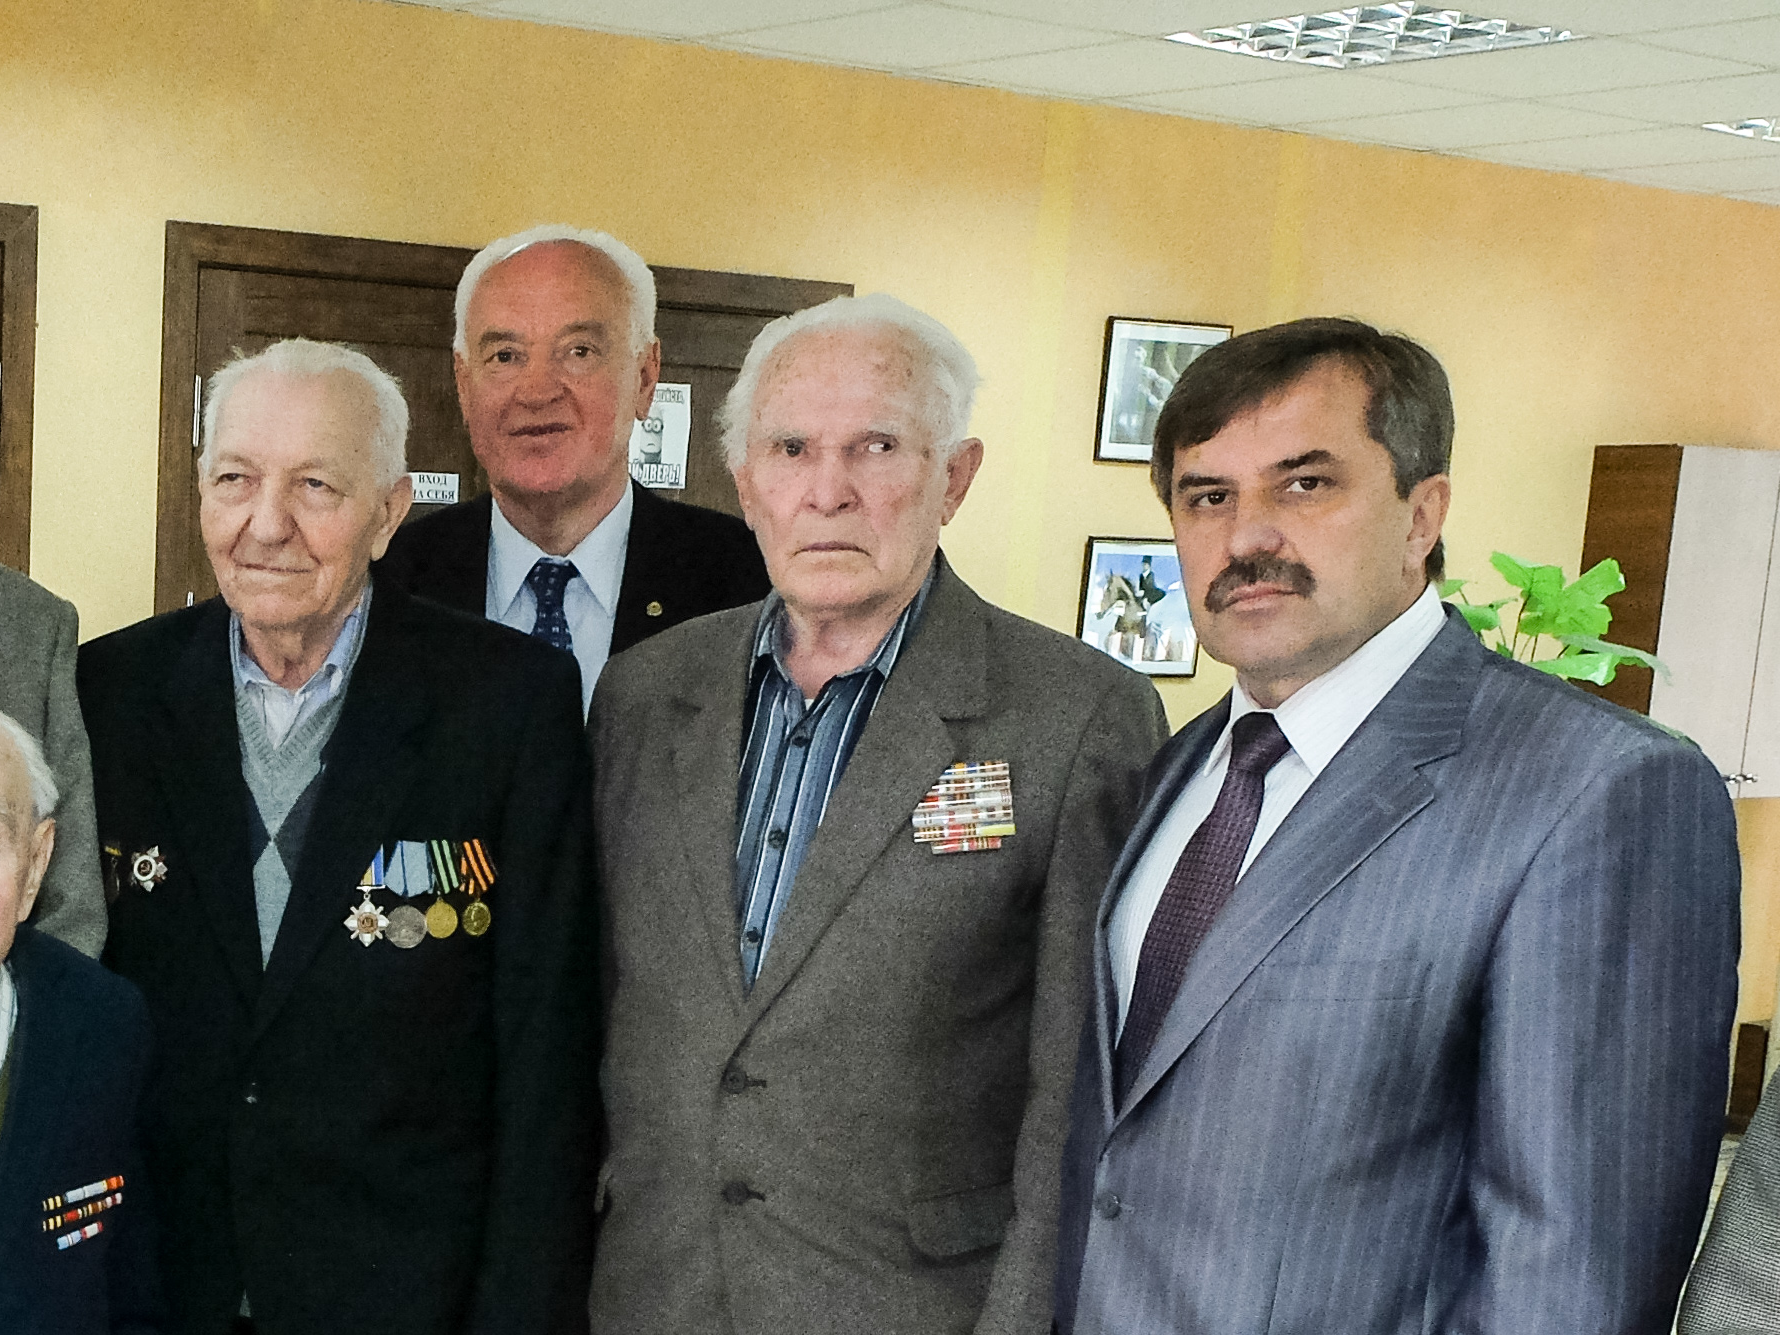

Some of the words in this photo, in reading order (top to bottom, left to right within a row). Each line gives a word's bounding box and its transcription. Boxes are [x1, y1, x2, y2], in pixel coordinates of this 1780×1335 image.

[418, 474, 447, 486] ВХОД
[641, 463, 681, 486] ДВЕРЬ!
[426, 489, 455, 500] СЕБЯ
